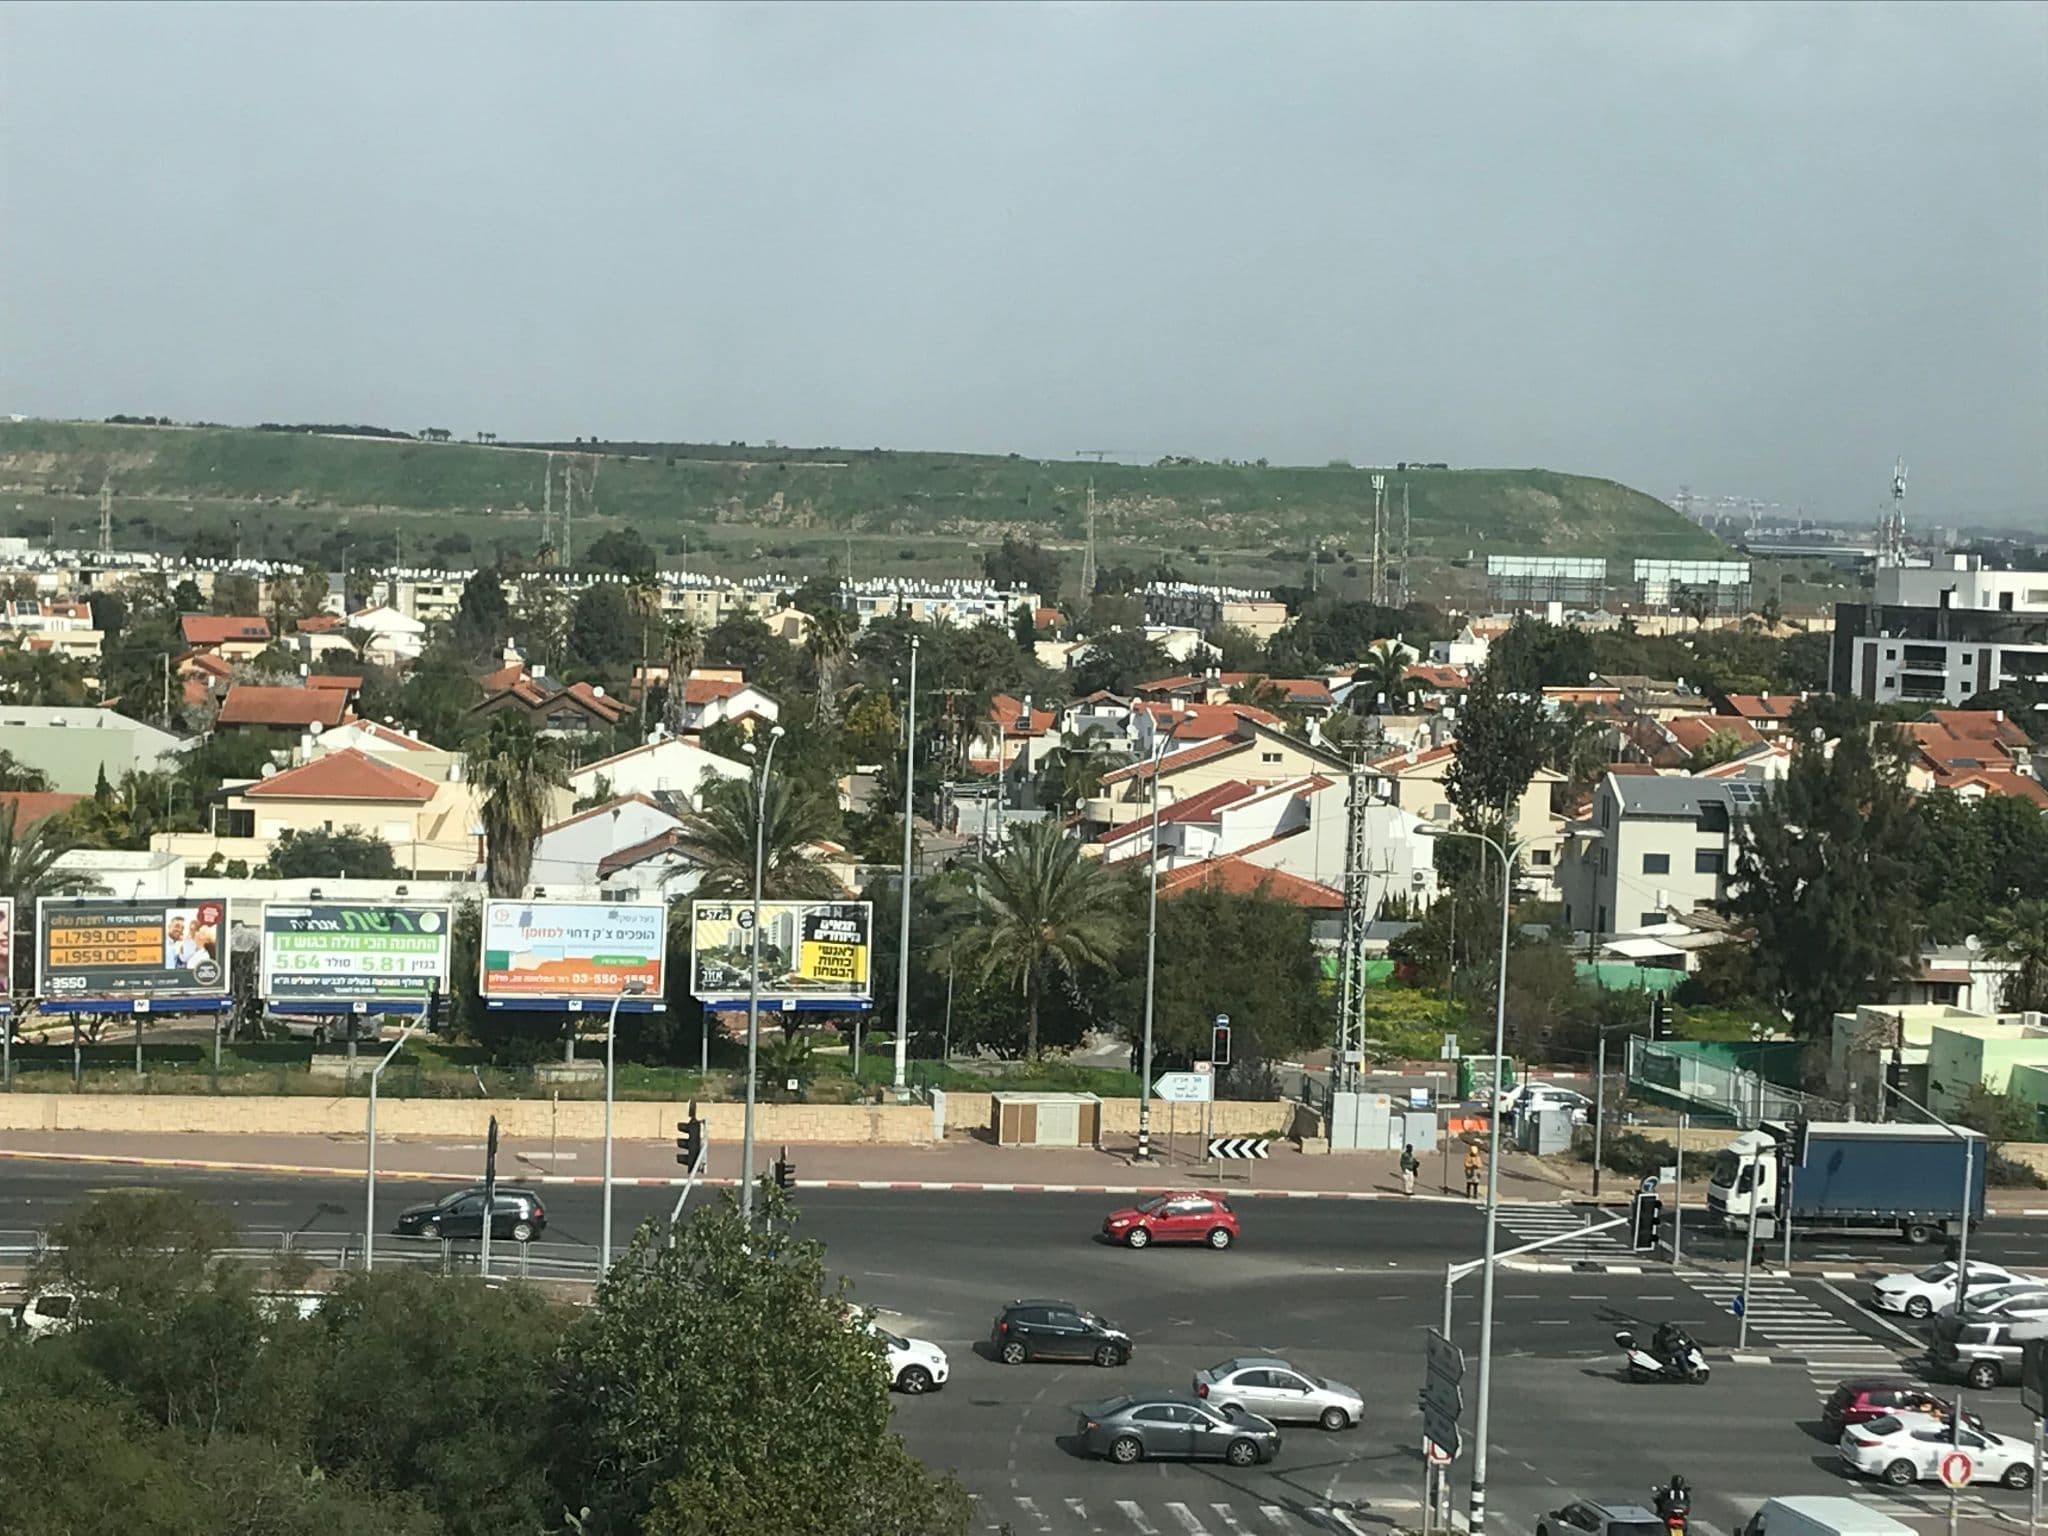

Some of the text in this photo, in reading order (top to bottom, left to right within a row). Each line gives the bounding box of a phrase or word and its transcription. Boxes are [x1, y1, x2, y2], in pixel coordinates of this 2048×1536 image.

[340, 910, 415, 932] רשת
[820, 919, 857, 932] תנאים
[522, 927, 563, 940] למזומן!
[567, 928, 589, 938] דחוי
[616, 928, 655, 940] הופכים
[813, 929, 861, 943] מיוחדים
[276, 936, 291, 950] דן
[294, 936, 328, 948] בגוש
[390, 937, 437, 950] התחנה
[818, 945, 854, 957] לאנשי
[276, 953, 320, 969] 5.64
[362, 956, 436, 971] בנזין 5.81
[818, 956, 852, 967] כוחות
[813, 966, 855, 979] הבטחון
